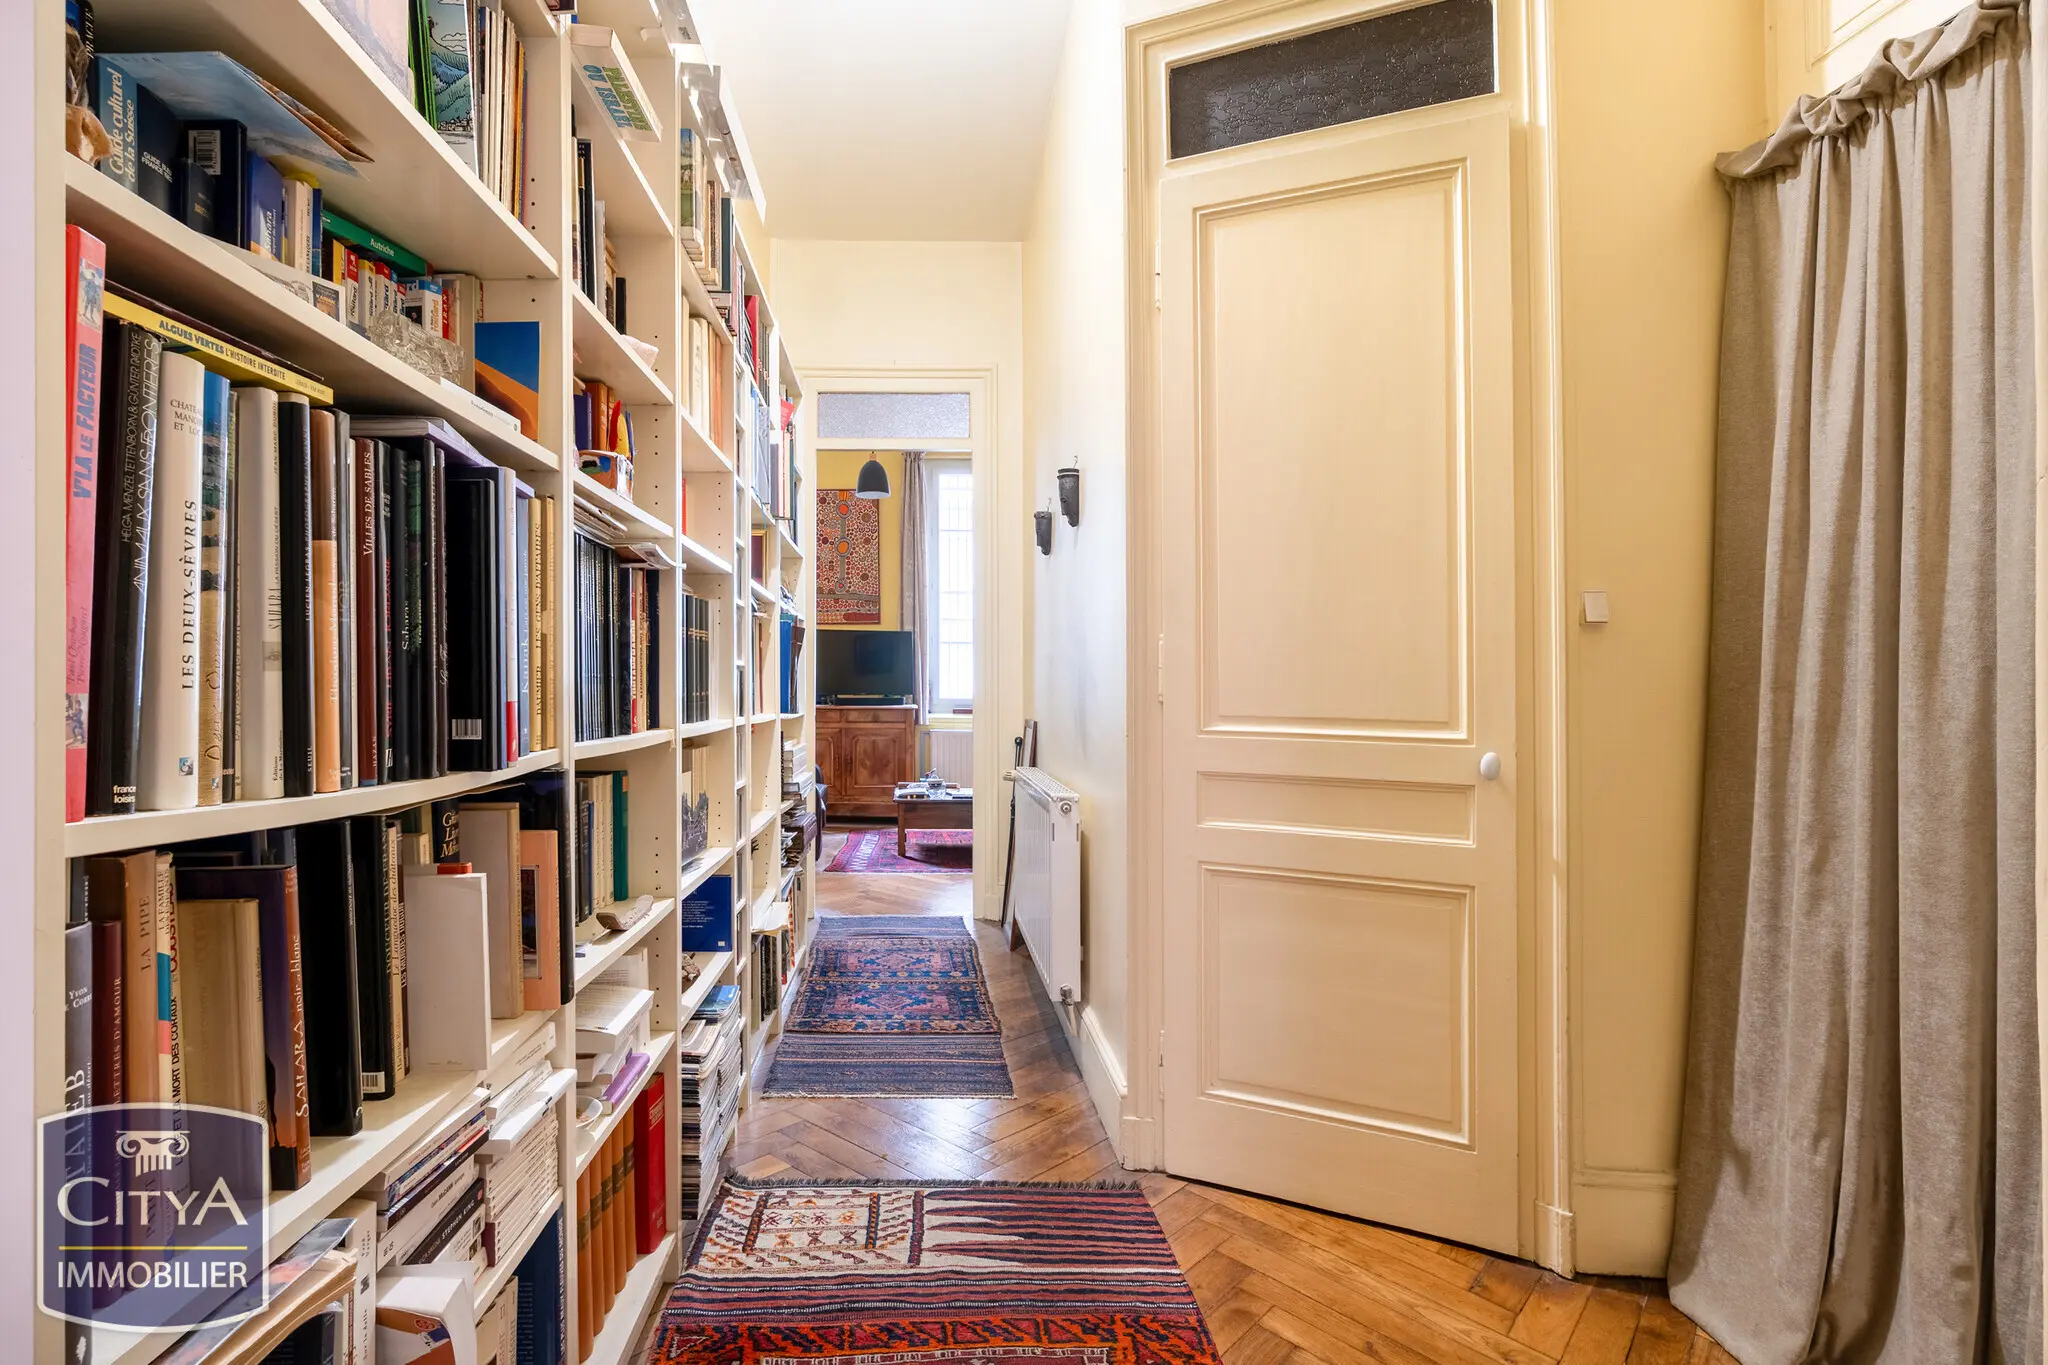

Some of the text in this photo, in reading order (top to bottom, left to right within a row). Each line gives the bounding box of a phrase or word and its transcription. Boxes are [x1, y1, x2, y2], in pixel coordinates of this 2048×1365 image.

[107, 67, 124, 174] Guide culturel
[123, 98, 133, 145] Suisse
[370, 238, 395, 257] Autriche
[131, 332, 142, 368] RADTKE
[159, 320, 287, 381] ALGUES VERTES L'HISTOIRE INTERDITE
[76, 343, 97, 431] FACTEUR
[80, 434, 94, 449] LE
[123, 477, 134, 515] MENZEL
[137, 449, 153, 502] SANS
[363, 452, 373, 556] VILLES DE SABLES
[121, 516, 132, 543] HELGA
[132, 503, 151, 593] ANIMAUX
[179, 500, 197, 690] LES DEUX-SÈVRES
[113, 784, 136, 794] france
[157, 870, 165, 916] FAMILLE
[389, 838, 401, 976] Le Languedoc des châteaux
[139, 896, 151, 973] LA PIPE
[290, 934, 302, 972] blanc
[113, 976, 122, 1040] D'AMOUR
[170, 999, 180, 1041] CORAUX
[171, 1041, 181, 1065] DES
[293, 1020, 309, 1118] SAHARA
[172, 1068, 182, 1098] MORT
[441, 1199, 475, 1240] STEPHEN KING
